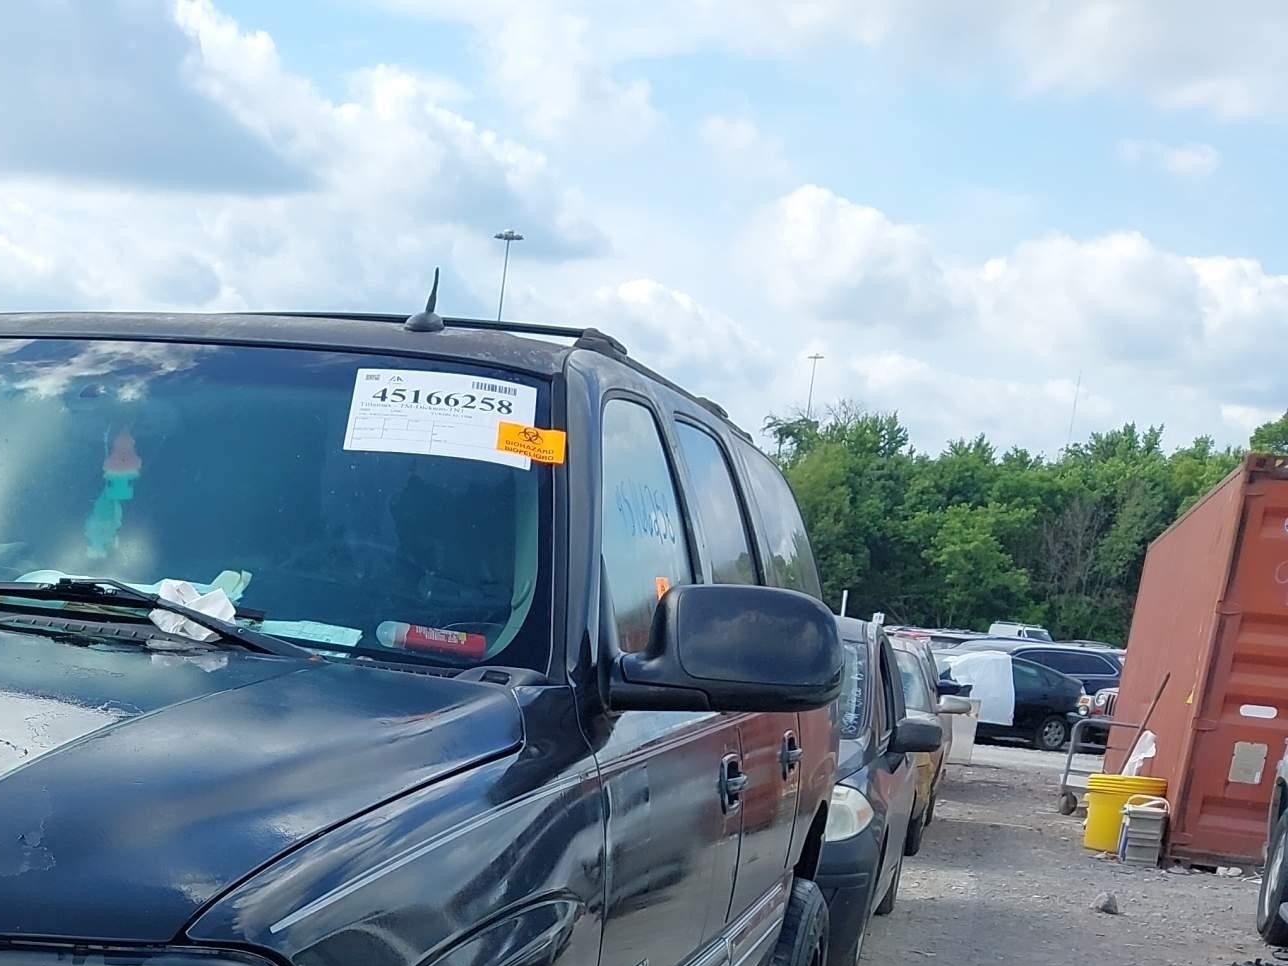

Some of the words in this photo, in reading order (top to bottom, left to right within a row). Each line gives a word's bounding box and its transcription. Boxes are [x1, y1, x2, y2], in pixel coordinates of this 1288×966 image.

[373, 388, 513, 415] 45166258
[505, 446, 554, 461] BIOPELIGRO
[506, 440, 554, 455] BIOHAZARD
